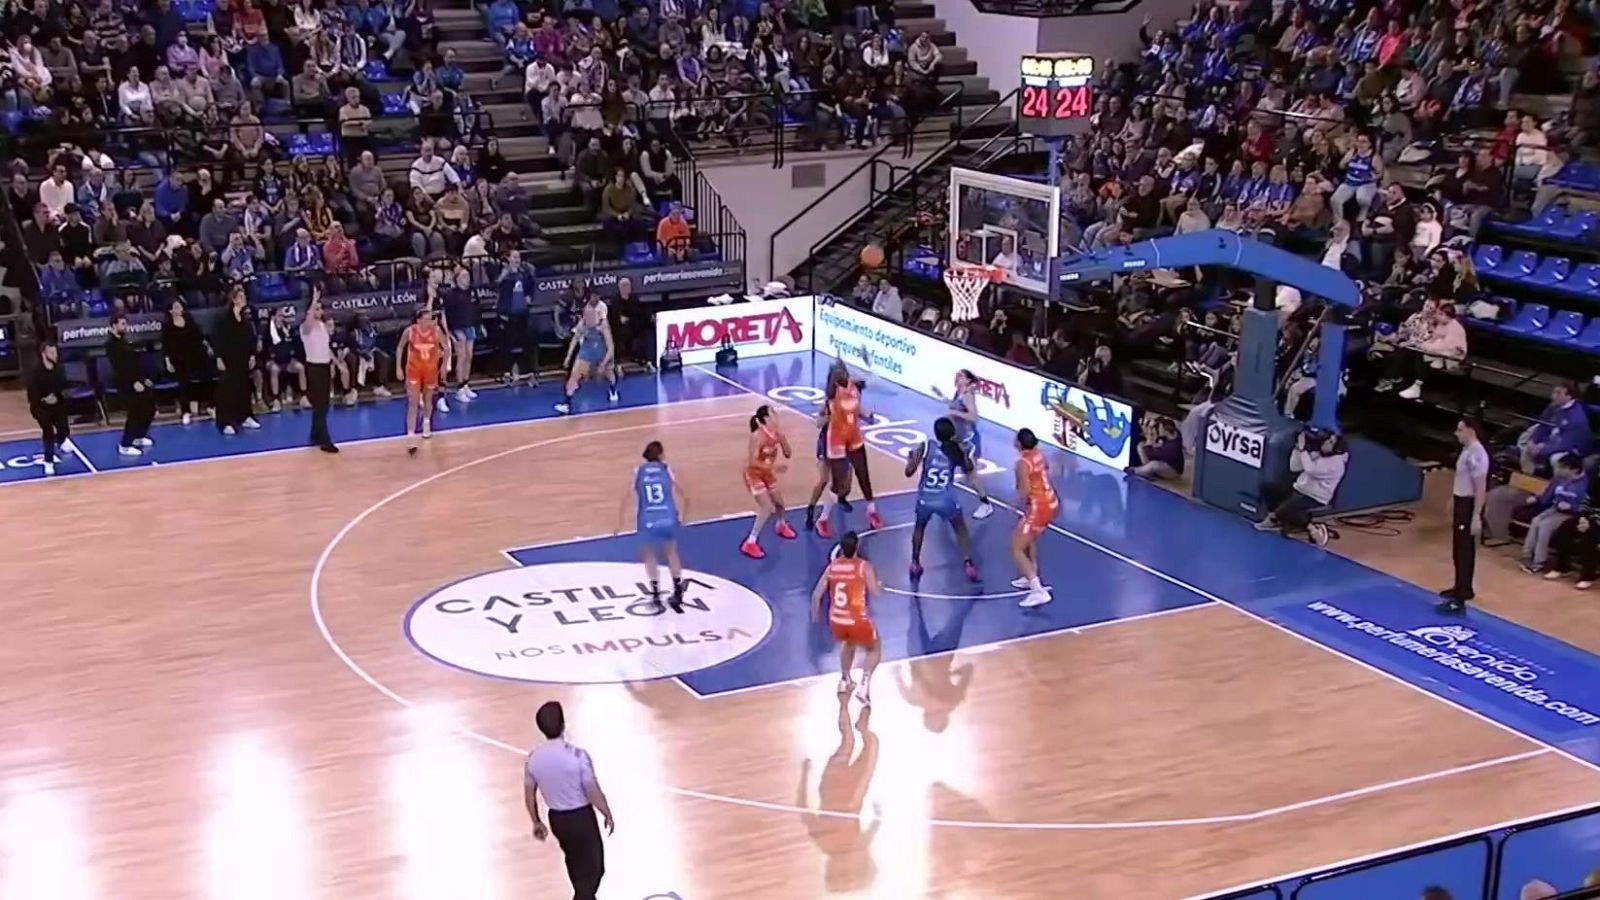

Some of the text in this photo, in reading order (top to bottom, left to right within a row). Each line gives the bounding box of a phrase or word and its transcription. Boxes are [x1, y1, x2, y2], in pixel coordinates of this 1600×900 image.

[1022, 86, 1048, 118] 24
[1055, 86, 1088, 118] 24
[538, 279, 573, 291] CASTIL
[332, 292, 417, 309] CASTILLA Y LEÓN
[63, 320, 162, 342] perfumervenida
[667, 306, 803, 349] MORETA
[820, 308, 916, 356] Equipamiento deportivo
[864, 349, 902, 374] fantiles
[926, 467, 949, 487] 55
[645, 483, 664, 503] 13
[435, 577, 716, 613] CASTILLA
[834, 582, 848, 607] 6
[485, 613, 523, 634] Y
[495, 644, 566, 660] NOS
[1306, 601, 1600, 726] www.perfumeriasavenida.com
